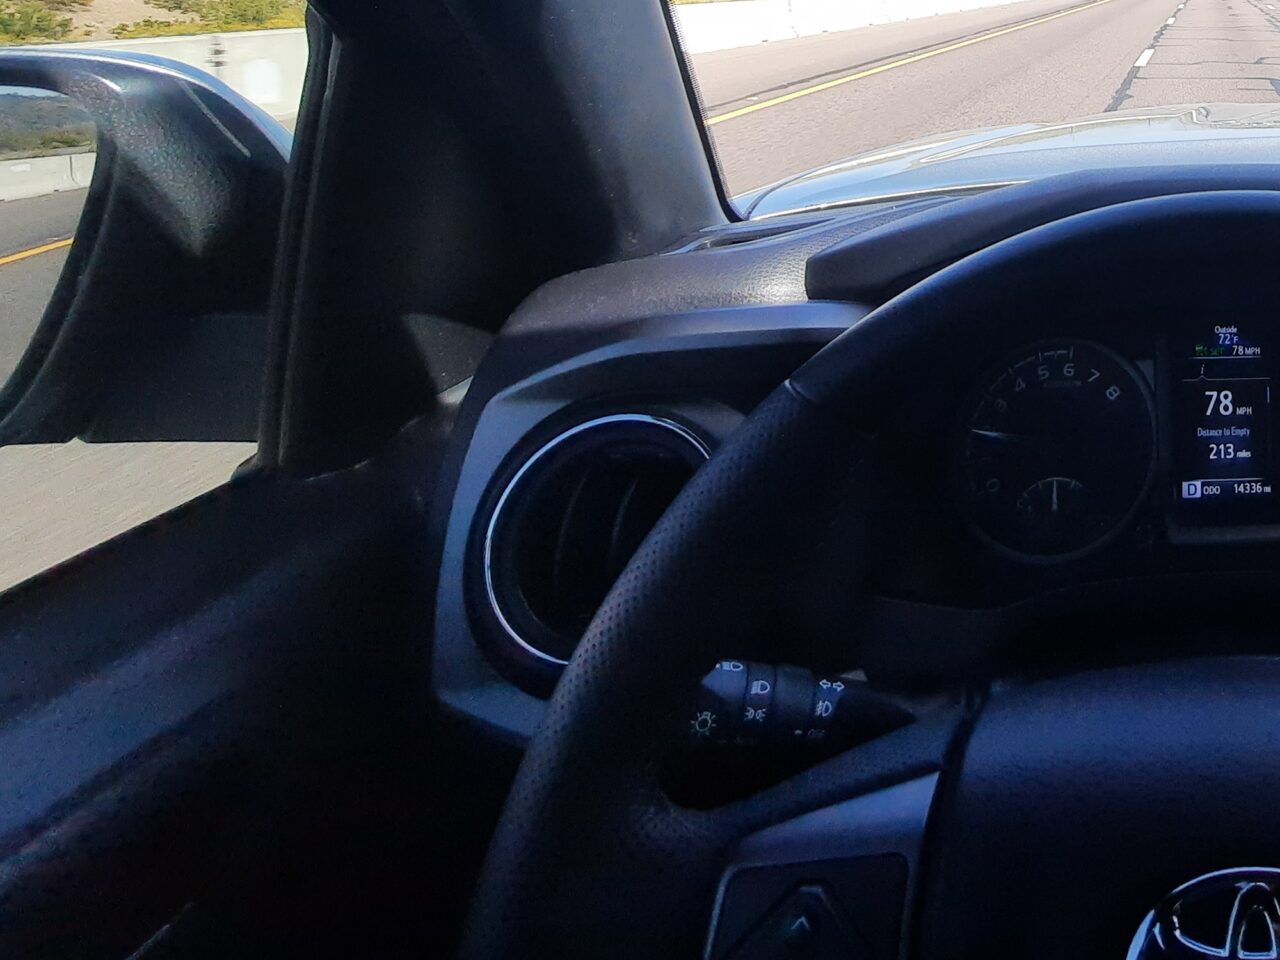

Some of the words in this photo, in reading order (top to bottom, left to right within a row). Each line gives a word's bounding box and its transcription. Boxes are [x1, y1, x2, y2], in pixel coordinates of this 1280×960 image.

[1214, 325, 1237, 334] Outside
[1232, 345, 1244, 356] 78
[1245, 346, 1261, 355] MPH
[1037, 364, 1051, 381] 5
[1062, 362, 1076, 378] 6
[1086, 367, 1102, 383] 7
[1014, 377, 1027, 393] 4
[1104, 383, 1121, 401] 8
[1204, 390, 1234, 416] 78
[1236, 406, 1253, 416] MPH
[1197, 427, 1223, 437] Distance
[1224, 426, 1231, 436] to
[1231, 426, 1251, 438] Empty
[1208, 443, 1235, 460] 213
[1236, 450, 1252, 459] miles
[1186, 483, 1198, 497] D
[1203, 485, 1221, 495] ODO
[1233, 482, 1262, 494] 14336
